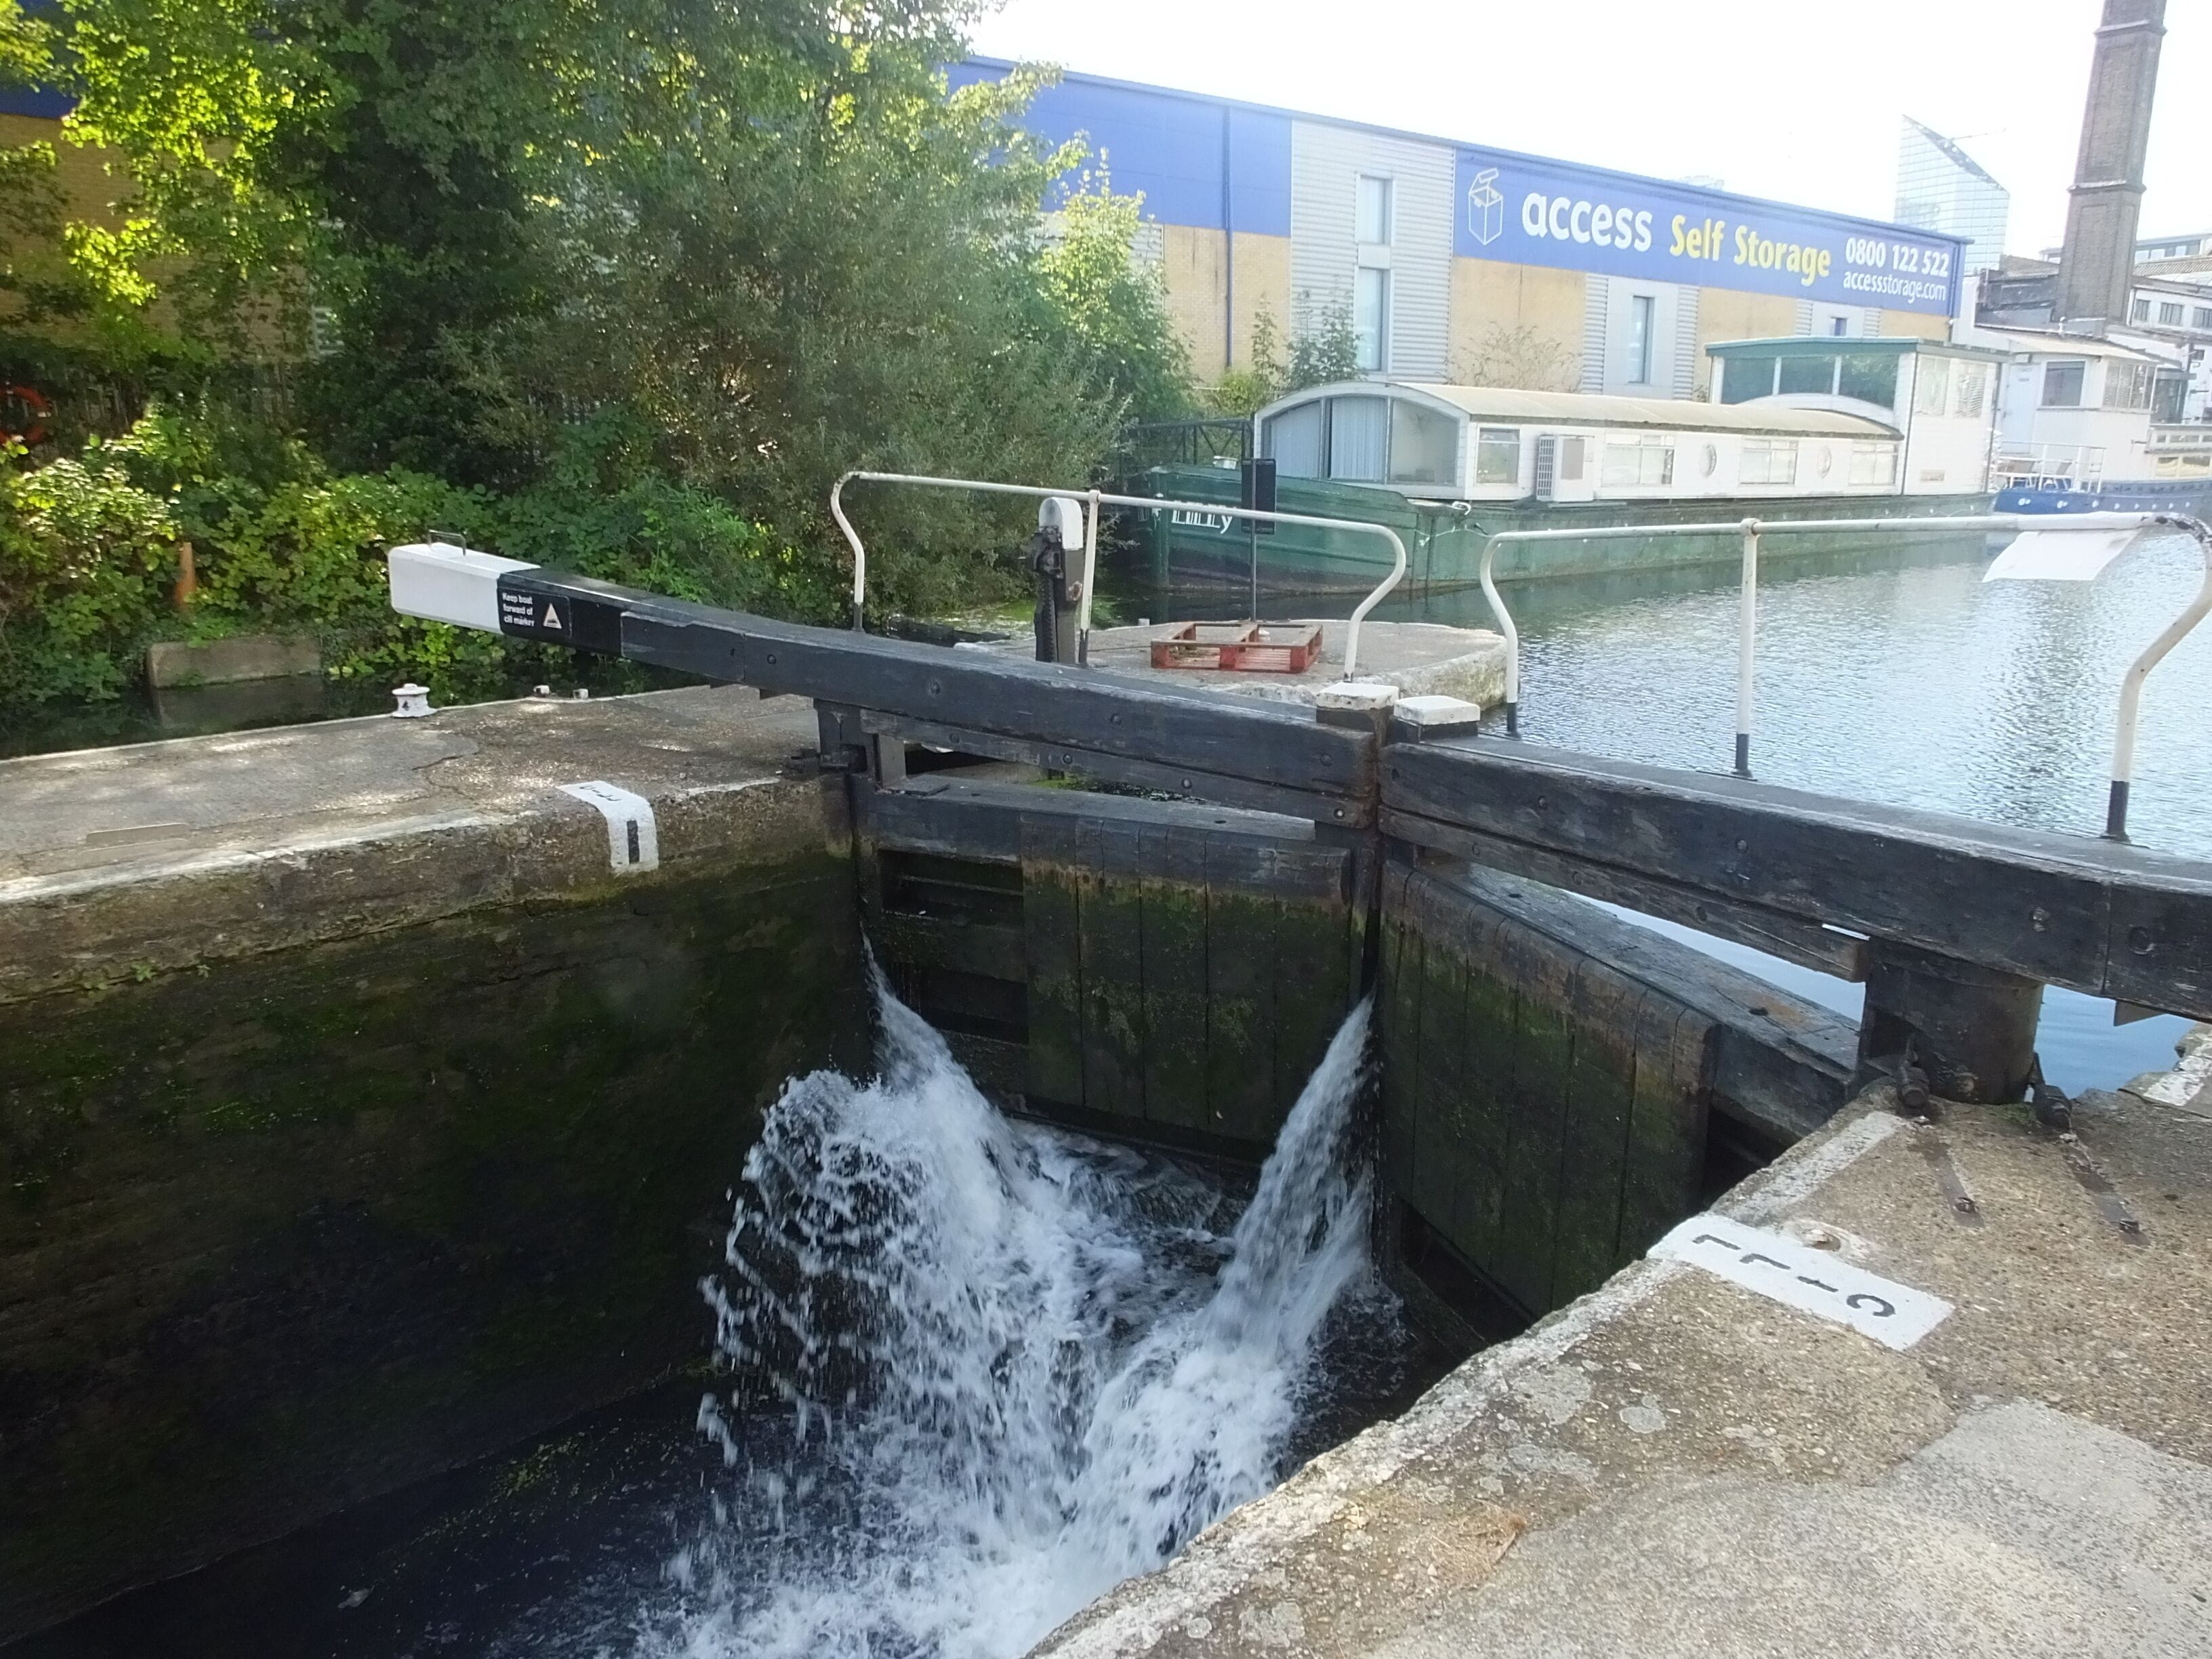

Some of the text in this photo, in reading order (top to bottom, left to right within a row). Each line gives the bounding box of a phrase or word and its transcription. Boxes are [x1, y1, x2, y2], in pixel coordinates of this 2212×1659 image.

[1522, 192, 1831, 287] access Self Storage
[1845, 237, 1950, 277] 0800 122 522
[1843, 270, 1947, 304] accessstorage.com
[502, 592, 533, 605] Keep boat
[503, 603, 533, 615] forward of
